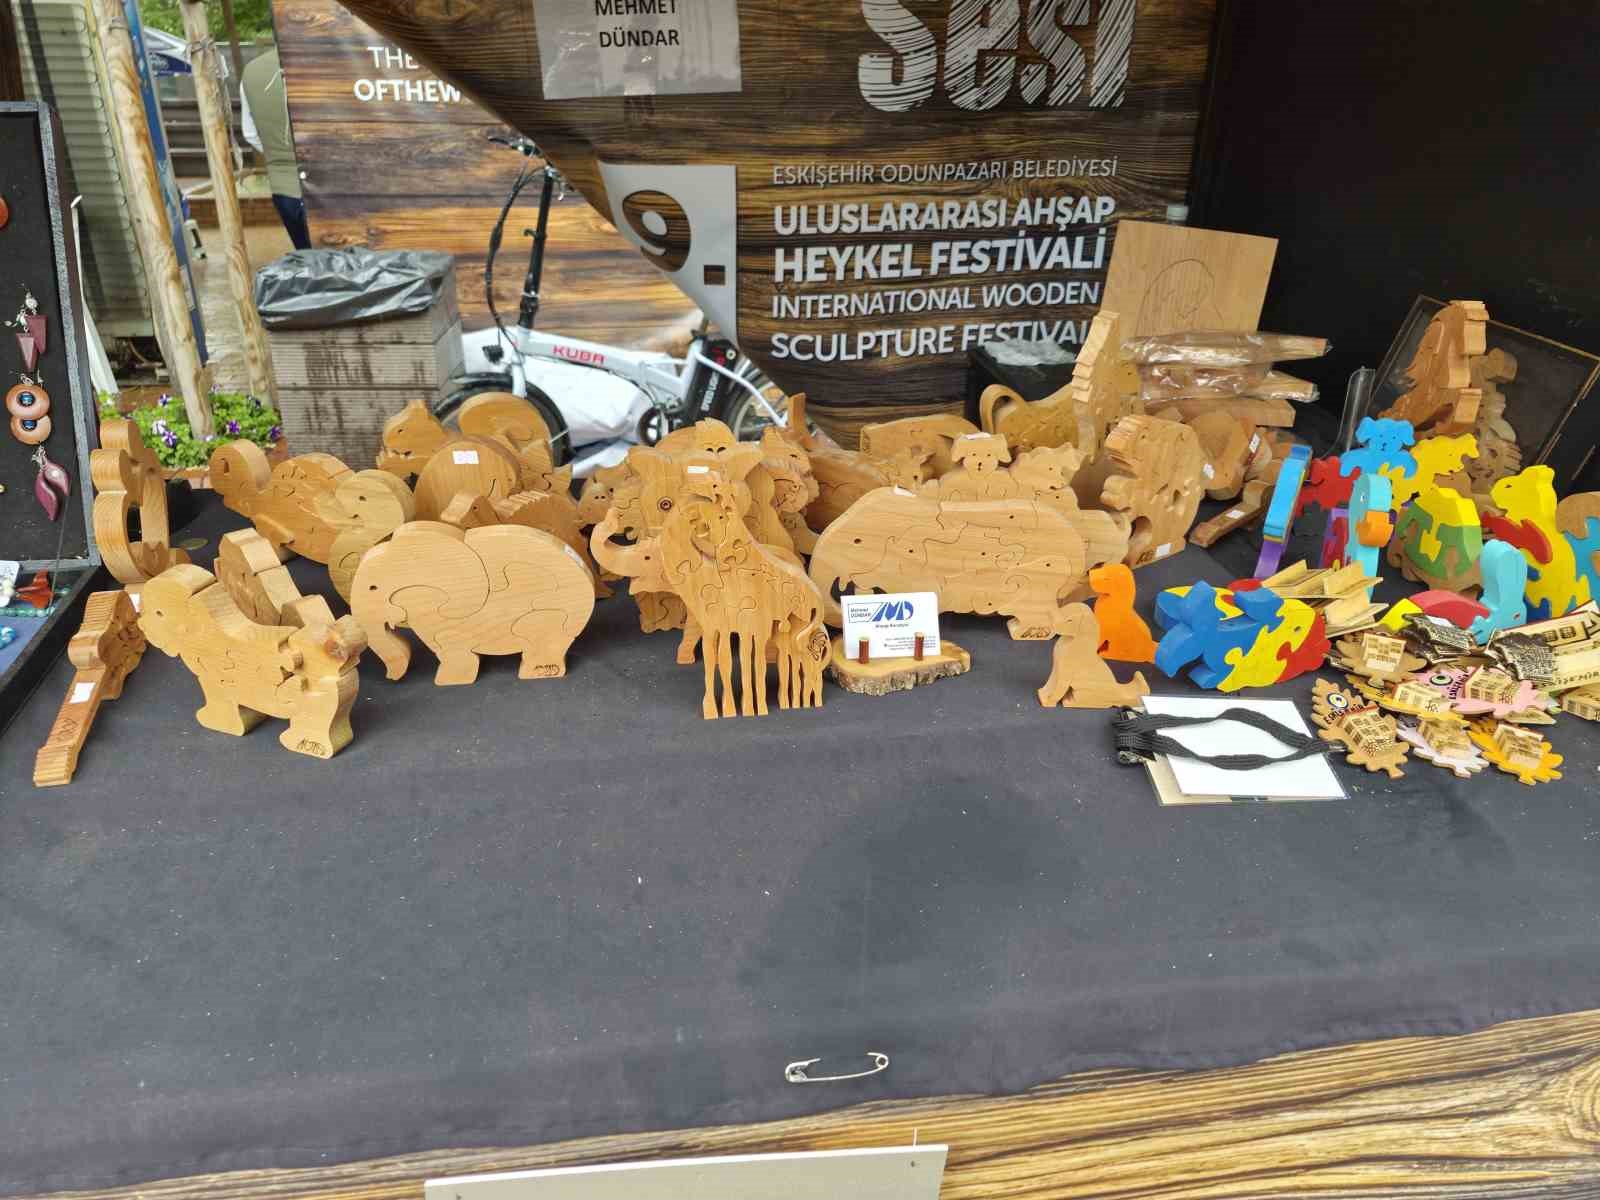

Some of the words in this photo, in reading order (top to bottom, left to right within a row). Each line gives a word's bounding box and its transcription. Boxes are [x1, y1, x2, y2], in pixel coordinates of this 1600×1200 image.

[595, 0, 677, 16] MEHMET
[600, 27, 680, 48] DÜNDAR
[773, 161, 875, 189] ESKİŞEHİR
[880, 161, 1007, 183] ODUNPAZARI
[1012, 155, 1118, 179] BELEDİYESİ
[774, 198, 1007, 236] ULUSLARARASI
[1011, 195, 1117, 232] AHŞAP
[774, 243, 923, 283] HEYKEL
[929, 226, 1107, 276] FESTİVALİ
[772, 287, 976, 319] INTERNATIONAL
[982, 281, 1100, 309] WOODEN
[553, 344, 608, 365] KUBA
[771, 324, 955, 362] SCULPTURE
